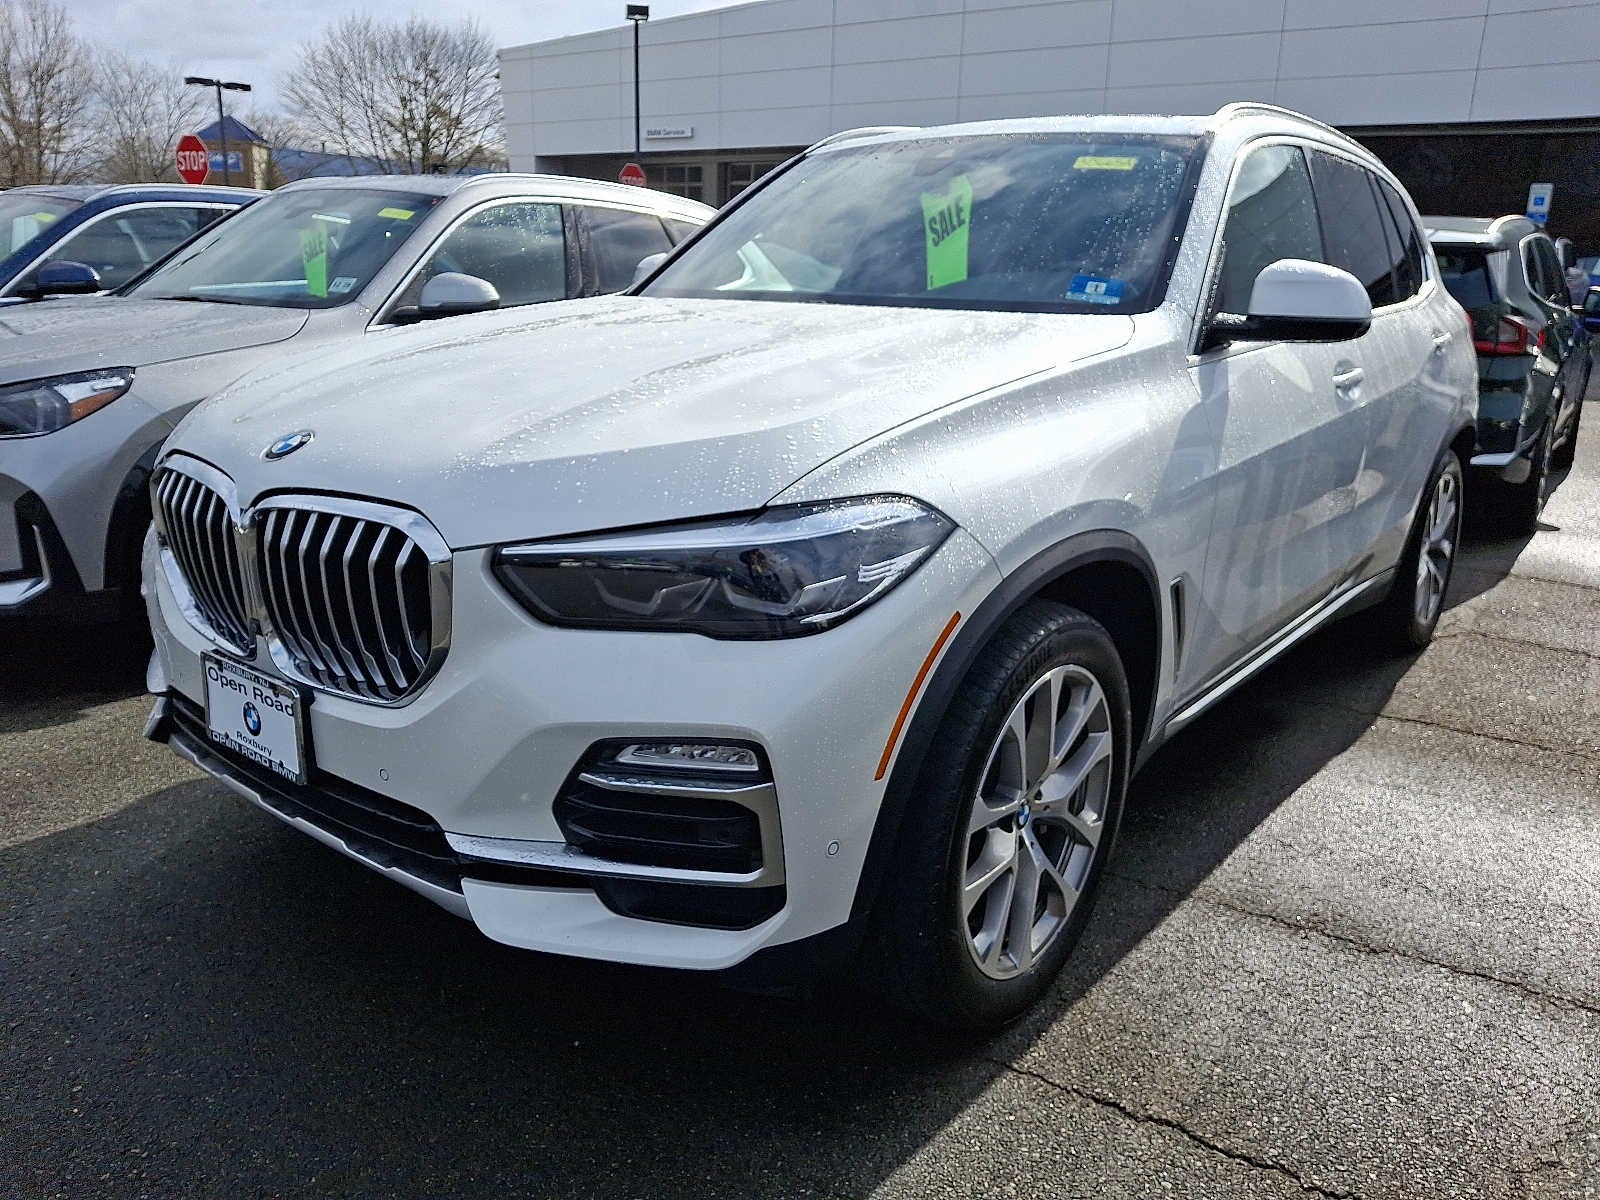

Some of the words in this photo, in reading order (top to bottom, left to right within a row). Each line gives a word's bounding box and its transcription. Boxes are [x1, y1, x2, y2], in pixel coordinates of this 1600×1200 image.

[177, 151, 205, 171] STOP
[928, 194, 966, 247] SALE
[303, 232, 325, 263] SALE
[207, 666, 248, 696] Open
[253, 686, 295, 717] Road
[212, 732, 239, 752] OPEN
[241, 746, 269, 767] ROAD
[271, 761, 297, 782] BMW
[236, 731, 272, 757] Roxbury
